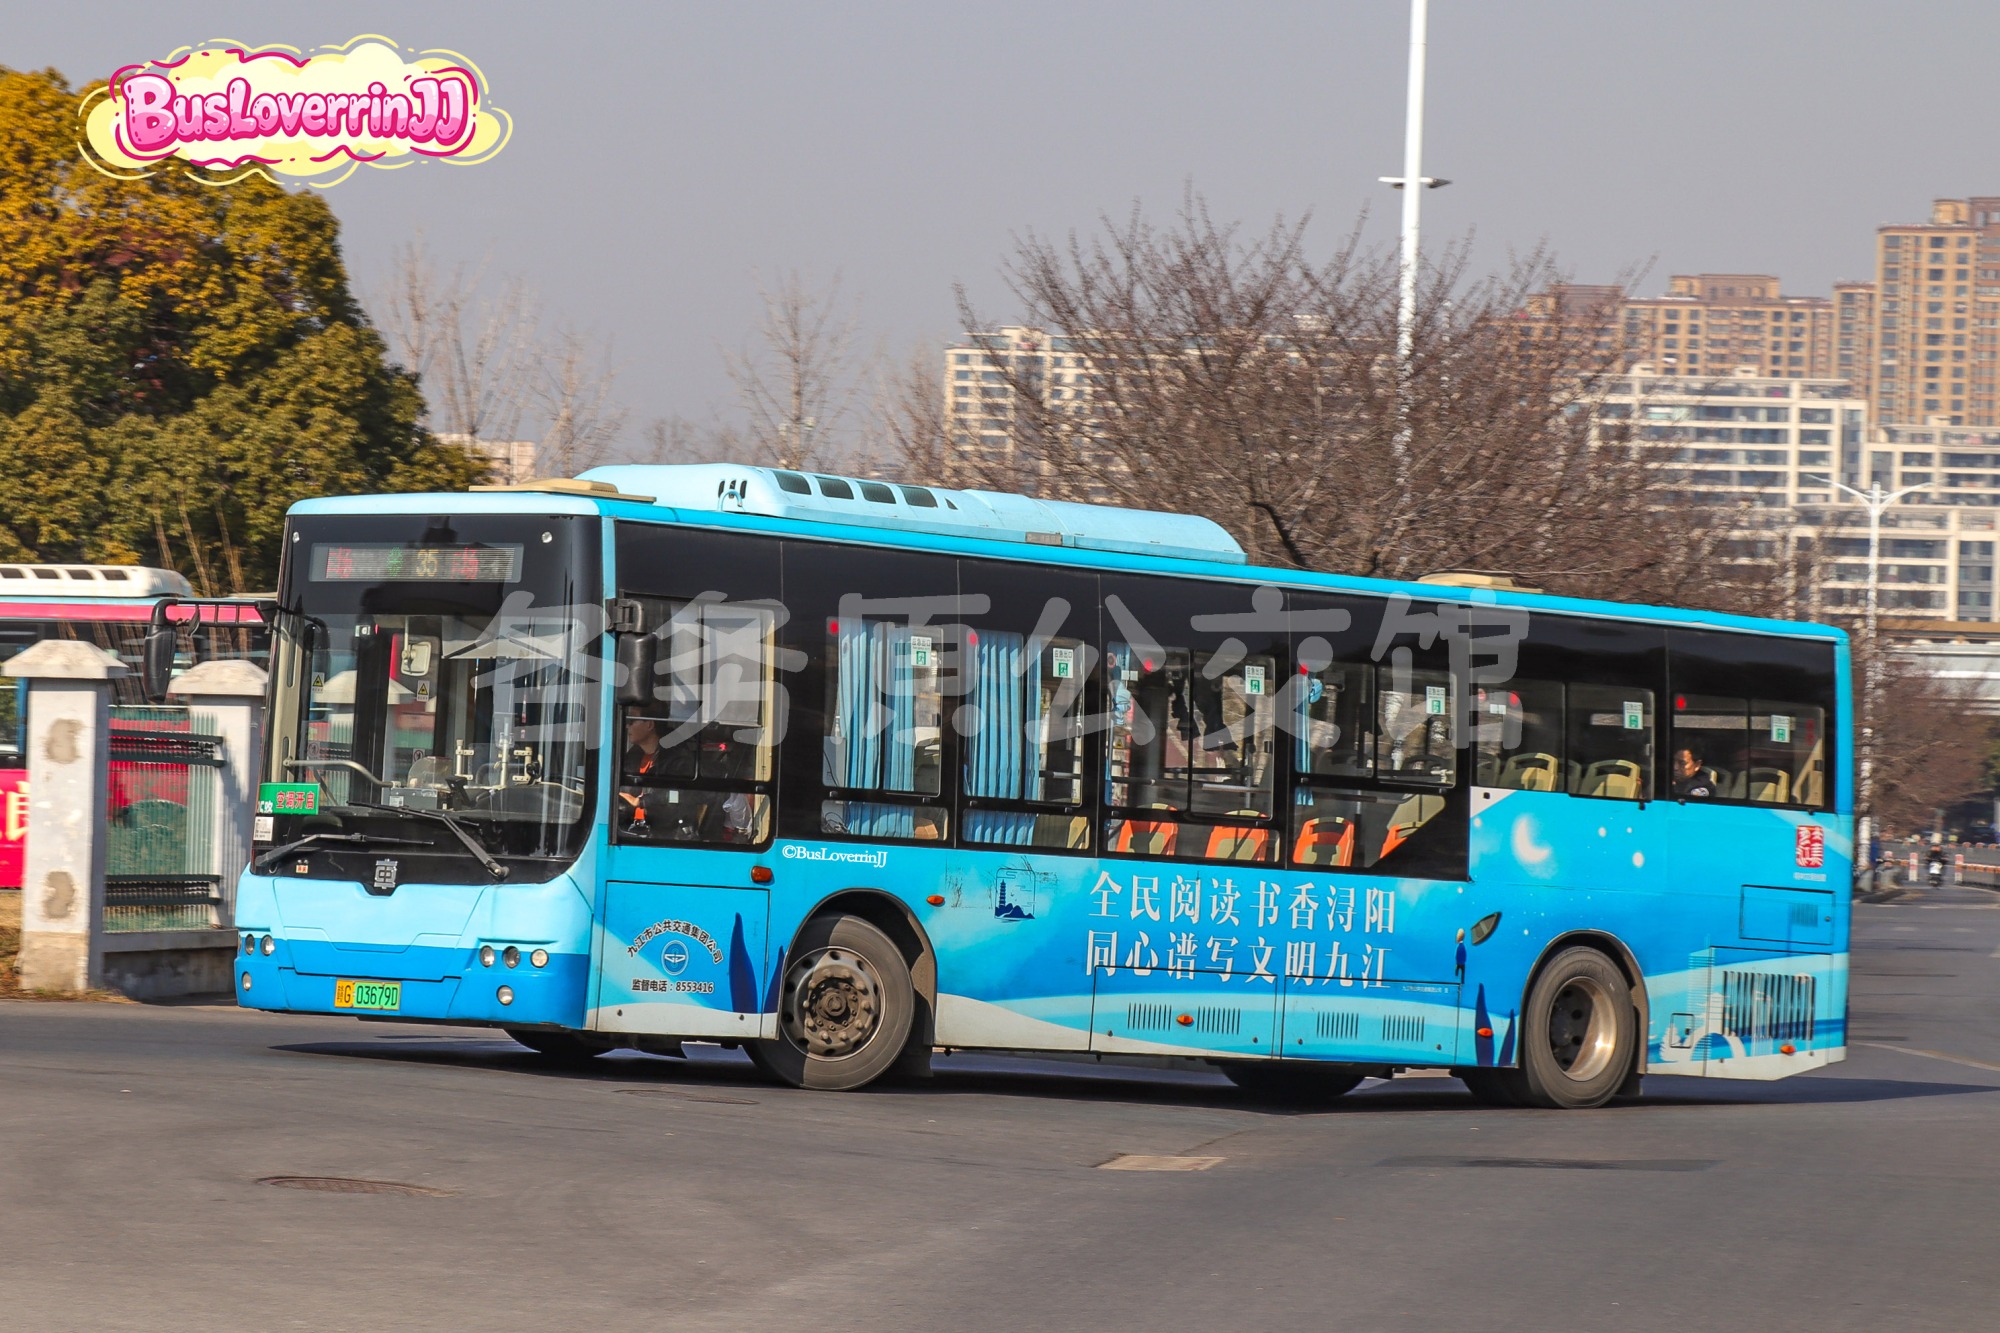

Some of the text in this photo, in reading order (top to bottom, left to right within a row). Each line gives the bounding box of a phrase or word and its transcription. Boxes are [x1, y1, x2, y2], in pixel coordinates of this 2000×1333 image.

[415, 549, 439, 577] 35
[1088, 870, 1396, 934] 全民阅读书香浔阳
[626, 919, 724, 965] 九江市公共交通集团公司
[1085, 929, 1393, 989] 同心谱写文明九江
